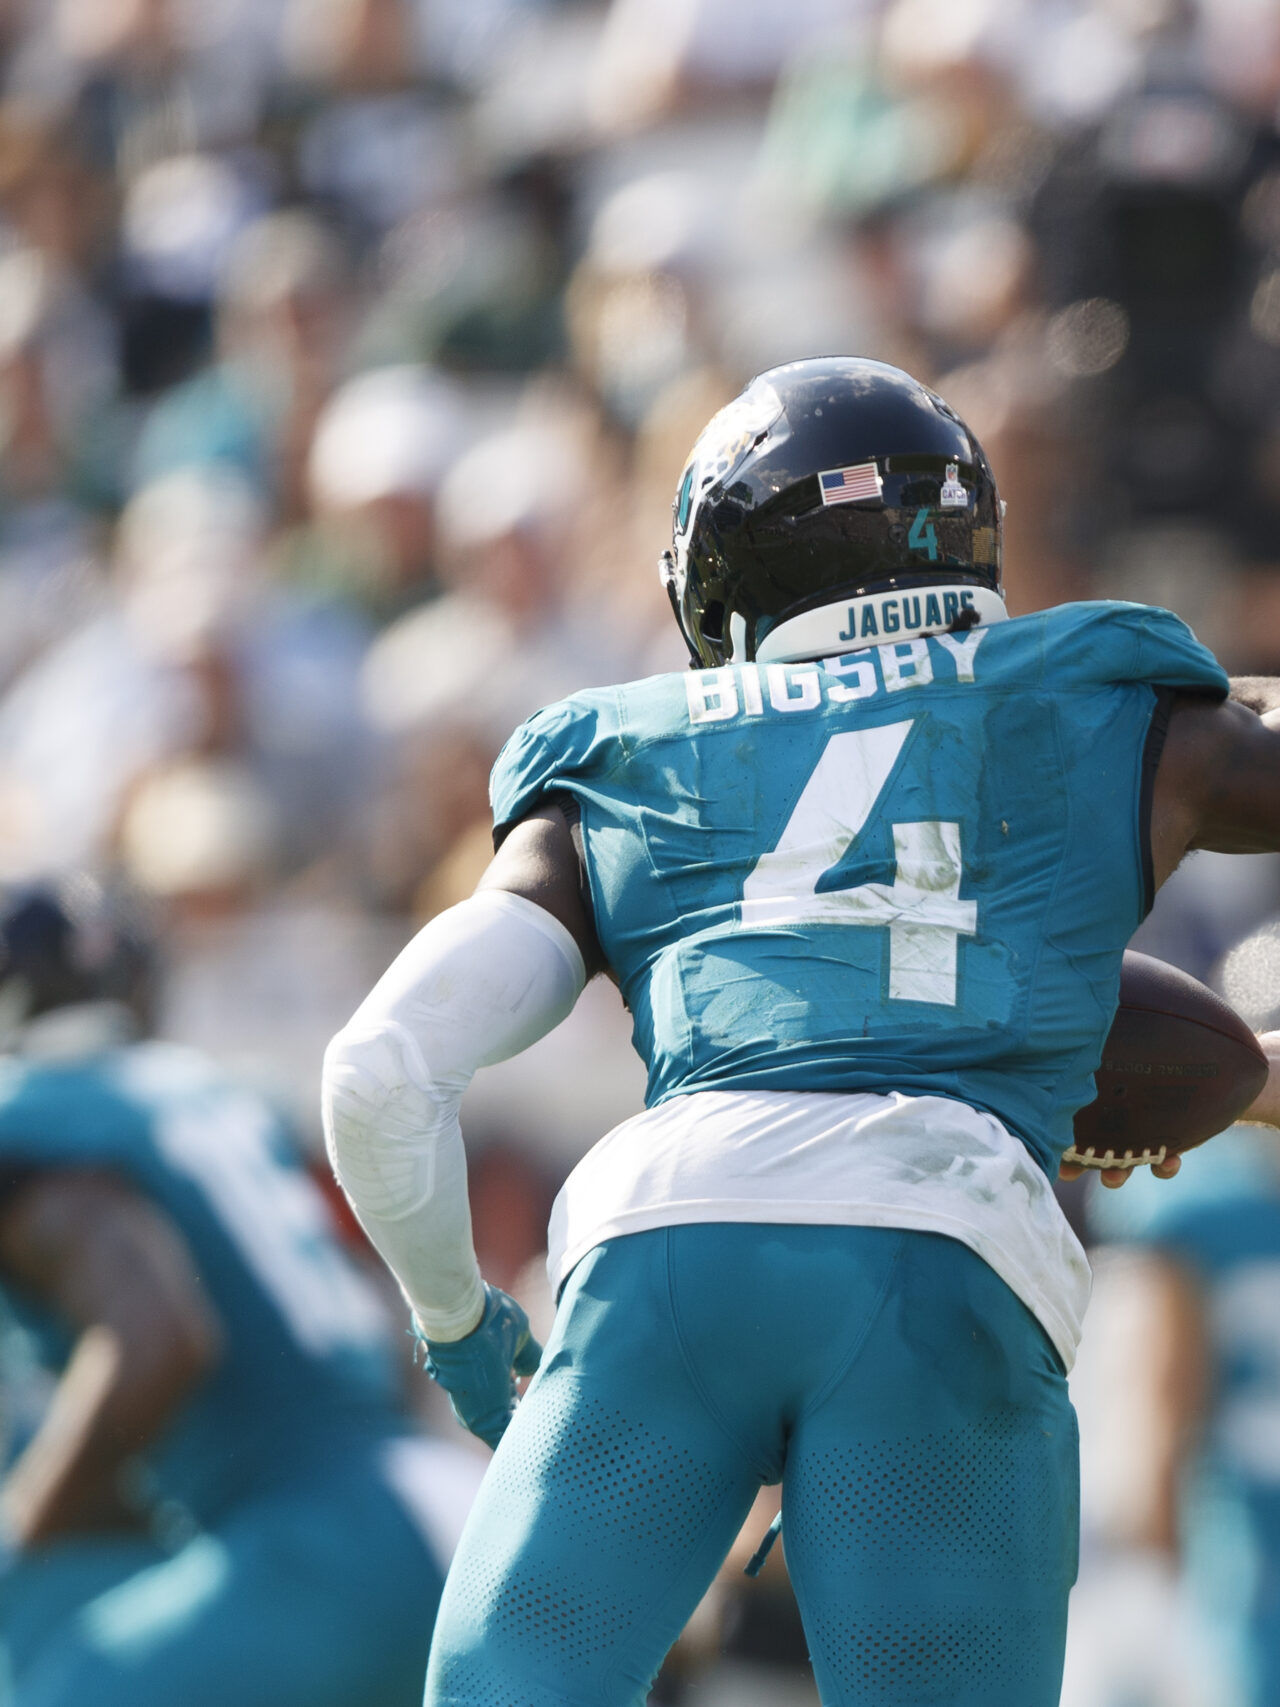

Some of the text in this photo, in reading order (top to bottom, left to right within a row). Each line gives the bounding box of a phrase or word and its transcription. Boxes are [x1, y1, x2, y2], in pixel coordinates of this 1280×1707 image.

[908, 507, 938, 561] 4
[684, 628, 989, 725] BIGSBY
[740, 718, 977, 1007] 4
